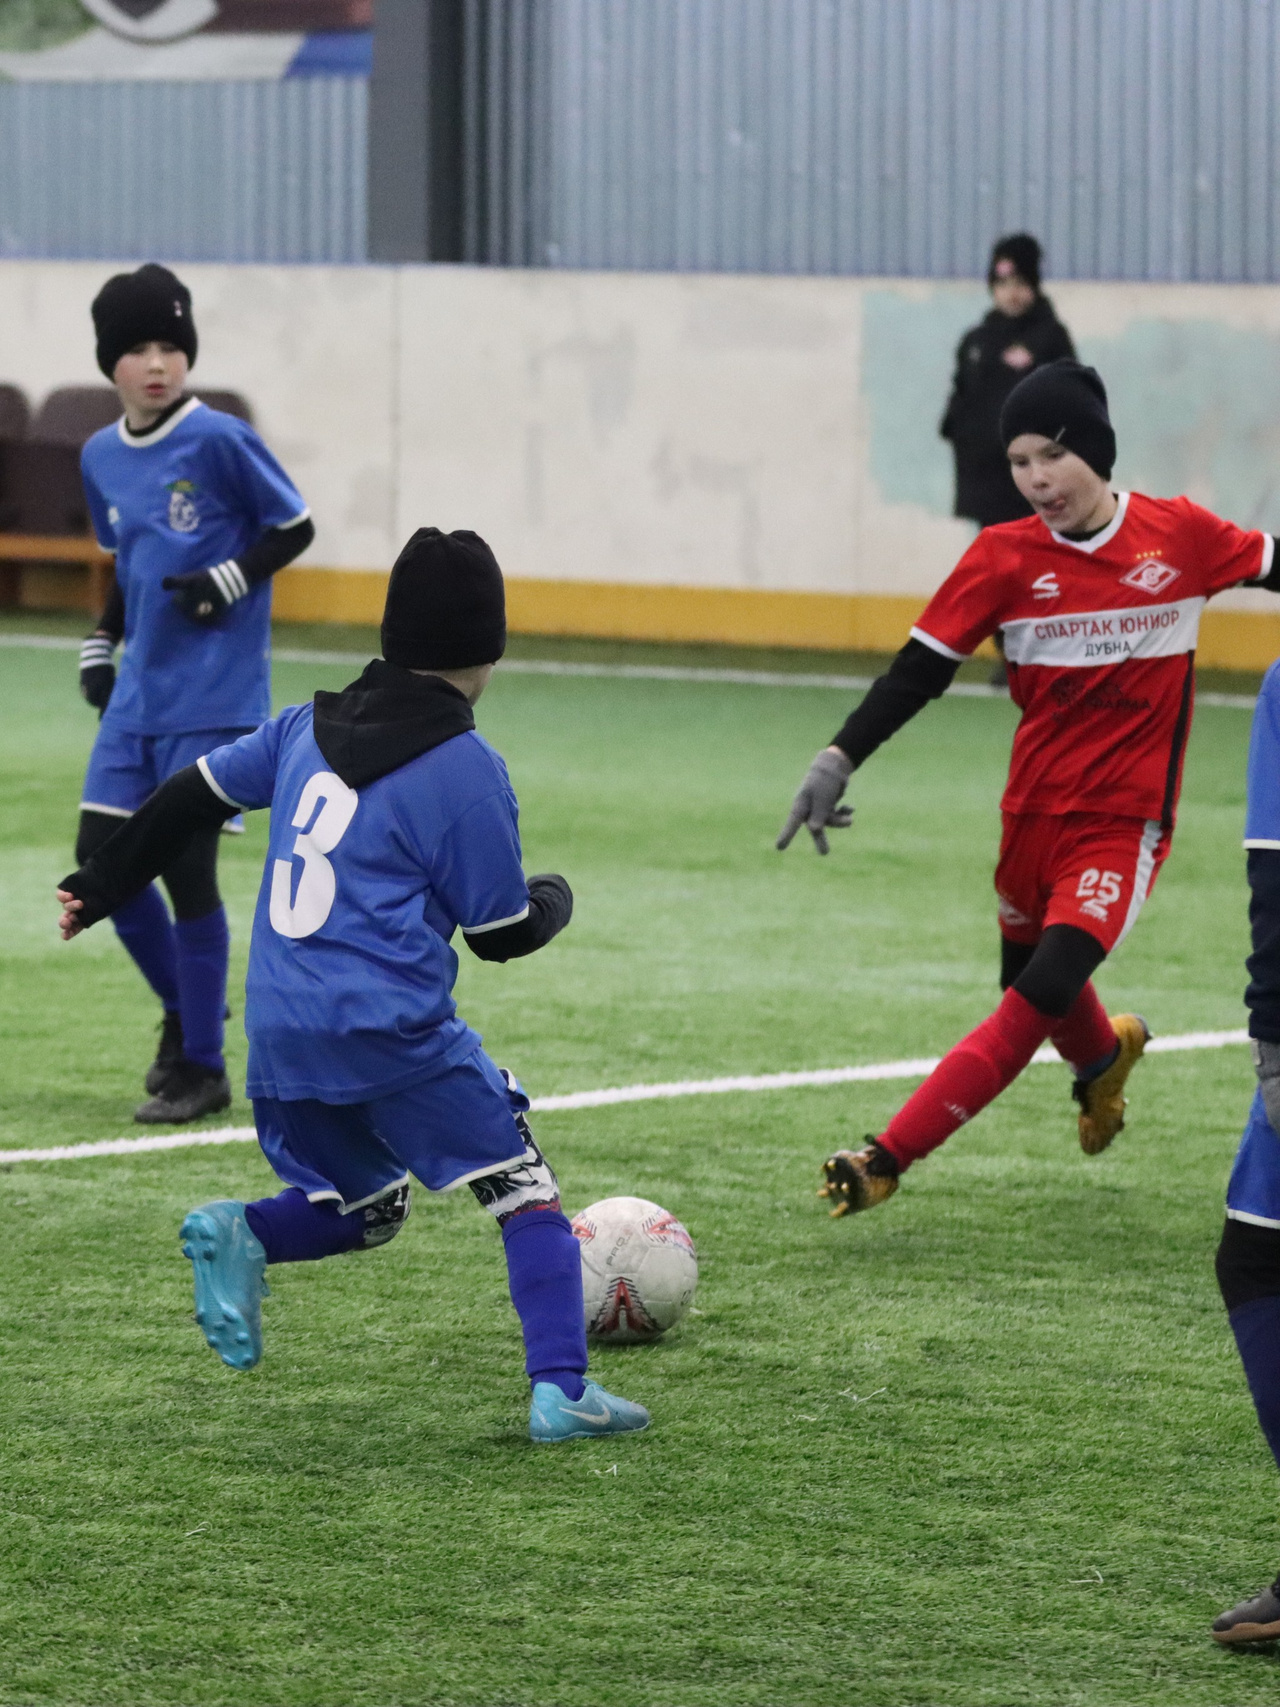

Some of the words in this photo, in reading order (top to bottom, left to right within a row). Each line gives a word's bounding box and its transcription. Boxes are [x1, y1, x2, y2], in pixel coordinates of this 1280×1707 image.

[1036, 618, 1114, 640] СПАРТАК
[1120, 611, 1180, 635] ЮНИОР
[1086, 641, 1131, 657] ДУБНА
[269, 771, 359, 939] 3
[1076, 868, 1124, 905] 25
